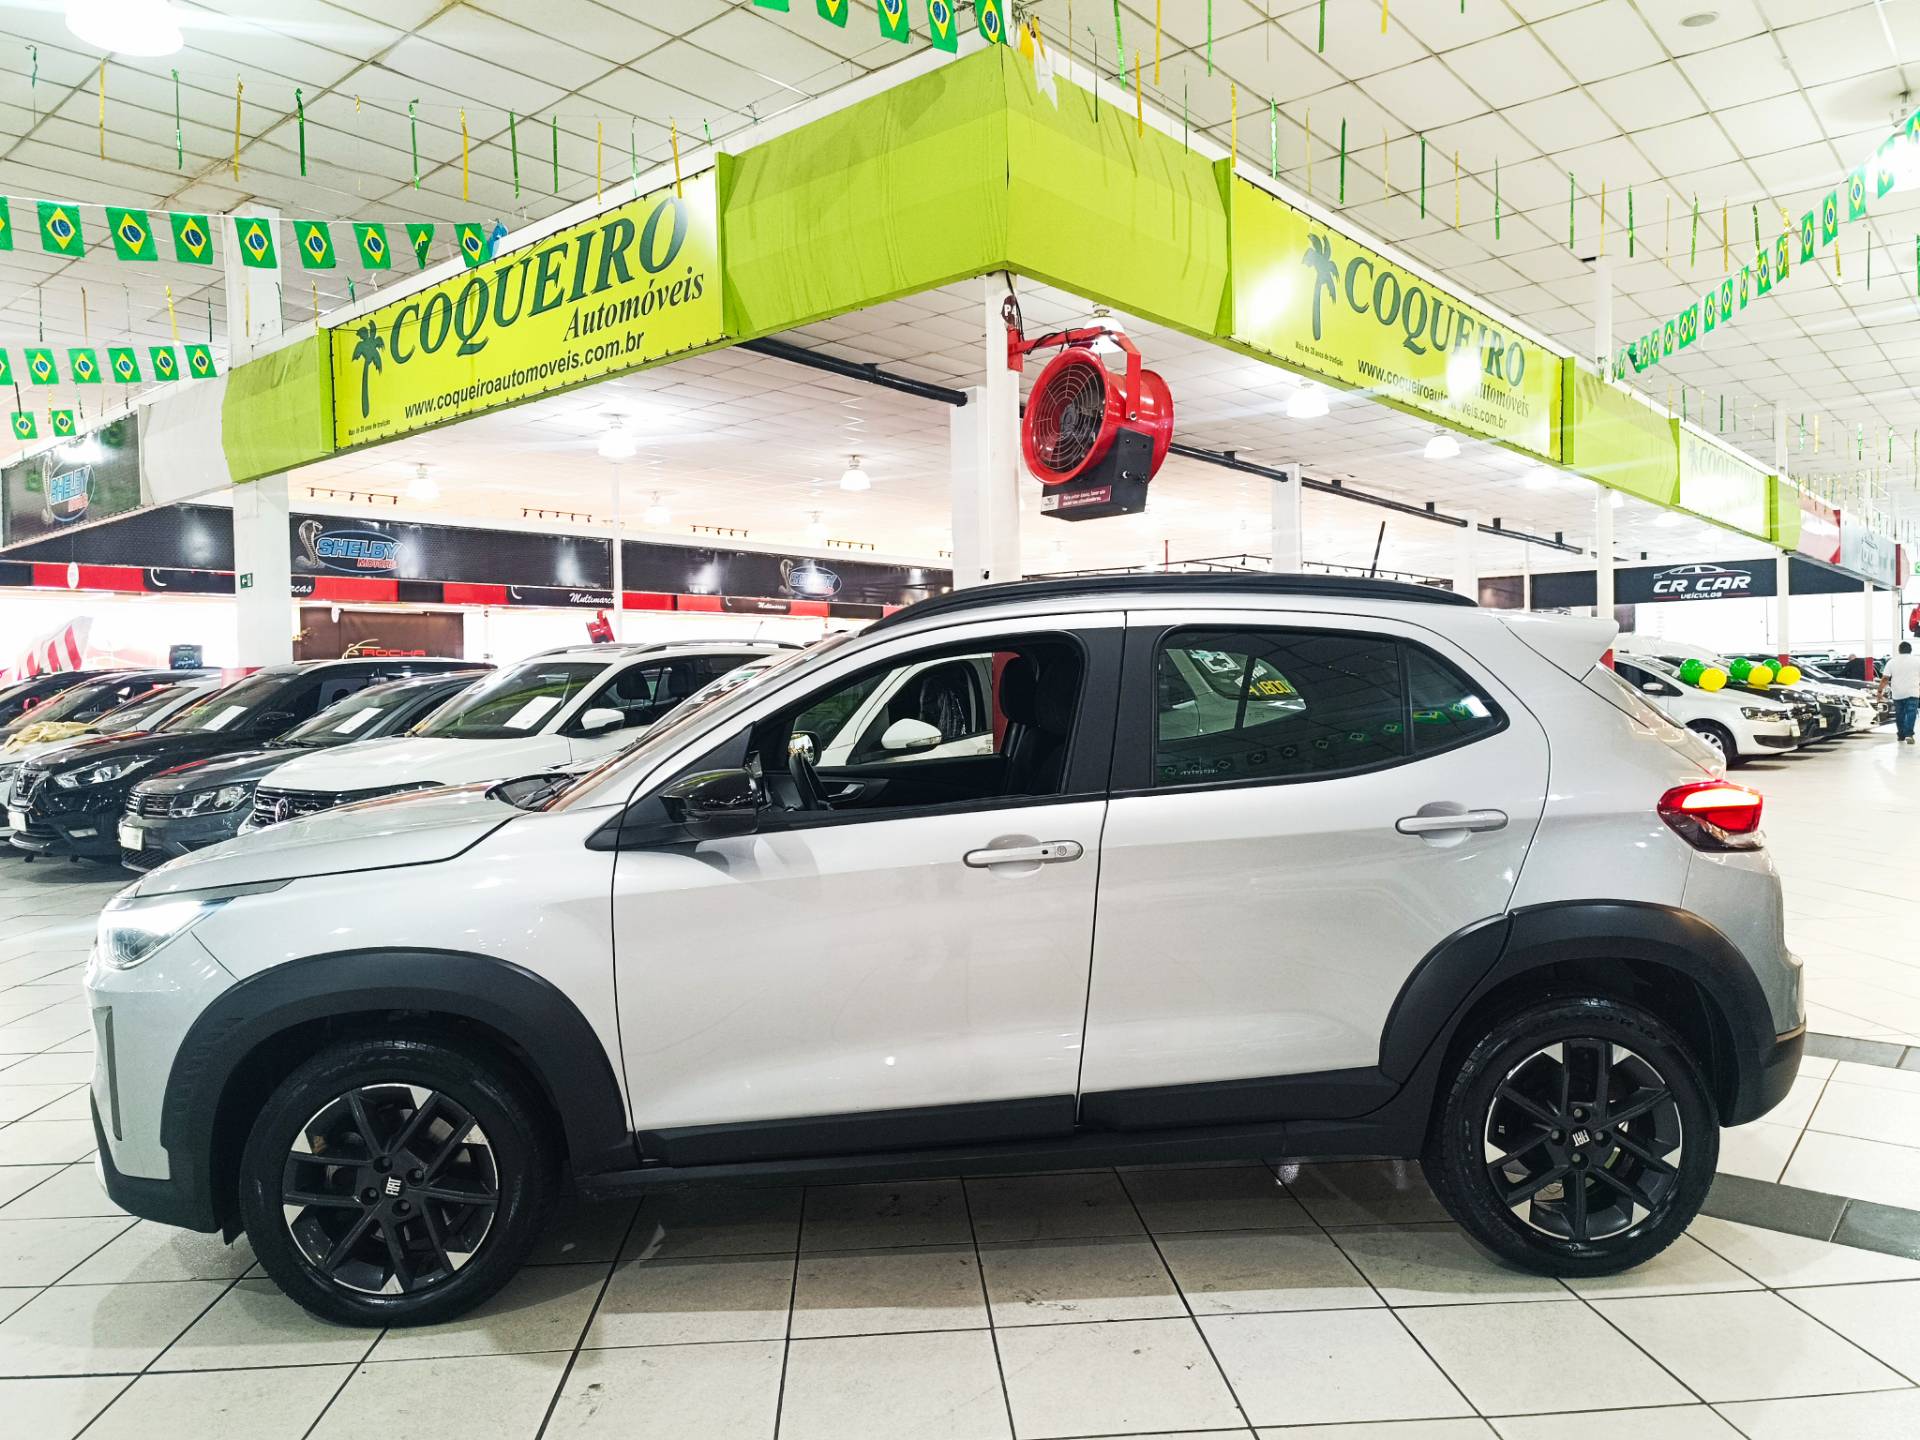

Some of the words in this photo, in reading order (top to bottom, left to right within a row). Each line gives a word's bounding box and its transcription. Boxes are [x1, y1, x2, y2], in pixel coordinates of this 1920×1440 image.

[389, 196, 688, 365] COQUEIRO
[563, 265, 704, 342] Automóveis
[404, 330, 645, 419] www.coqueiroautomoveis.com.br
[1357, 358, 1508, 430] www.coqueiroautveis.com.br
[1473, 379, 1529, 418] utomóveis
[316, 537, 402, 561] SHELBY
[1653, 579, 1688, 593] CR
[1695, 575, 1752, 591] CAR
[362, 649, 426, 657] ROCHA
[1572, 1129, 1590, 1147] FIAT
[385, 1176, 402, 1196] FIAT
